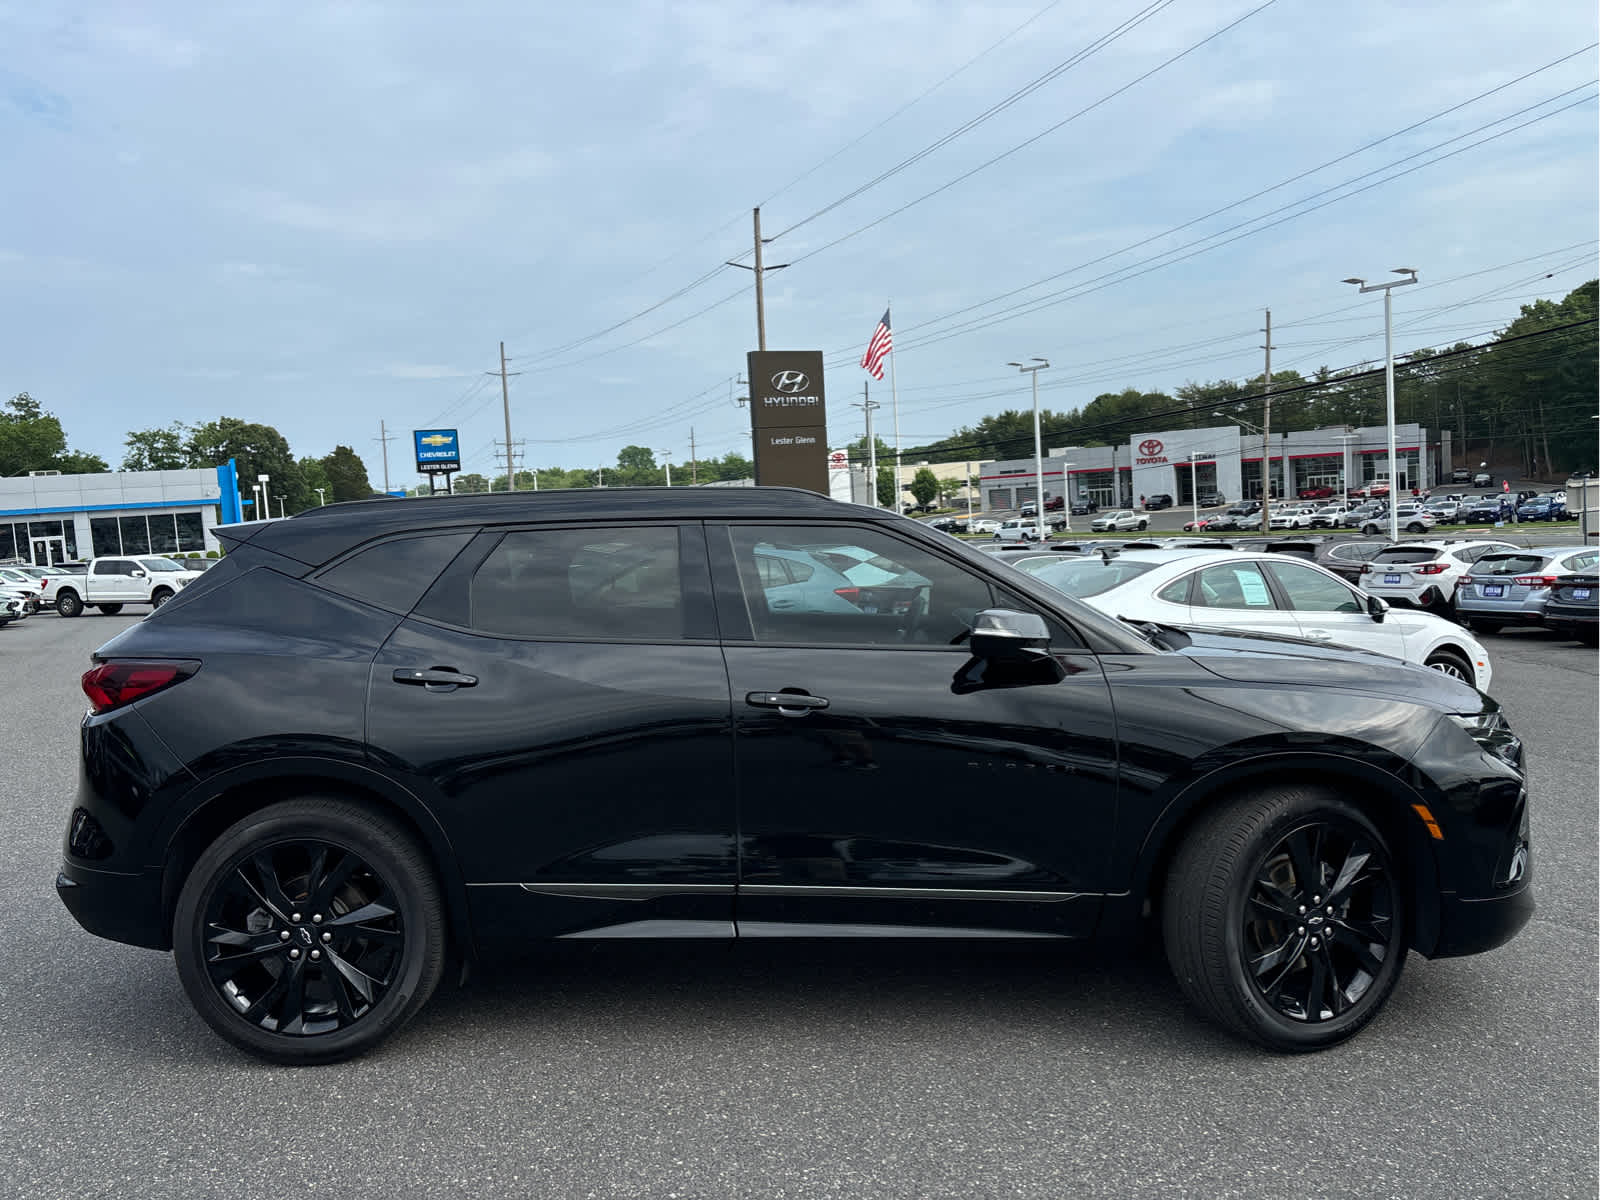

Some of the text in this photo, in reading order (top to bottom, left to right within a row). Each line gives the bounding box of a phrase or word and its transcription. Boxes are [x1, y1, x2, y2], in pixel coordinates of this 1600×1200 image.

[764, 396, 819, 407] HYUNDAI
[771, 436, 816, 445] Lester Glenn
[1136, 456, 1168, 464] TOYOTA
